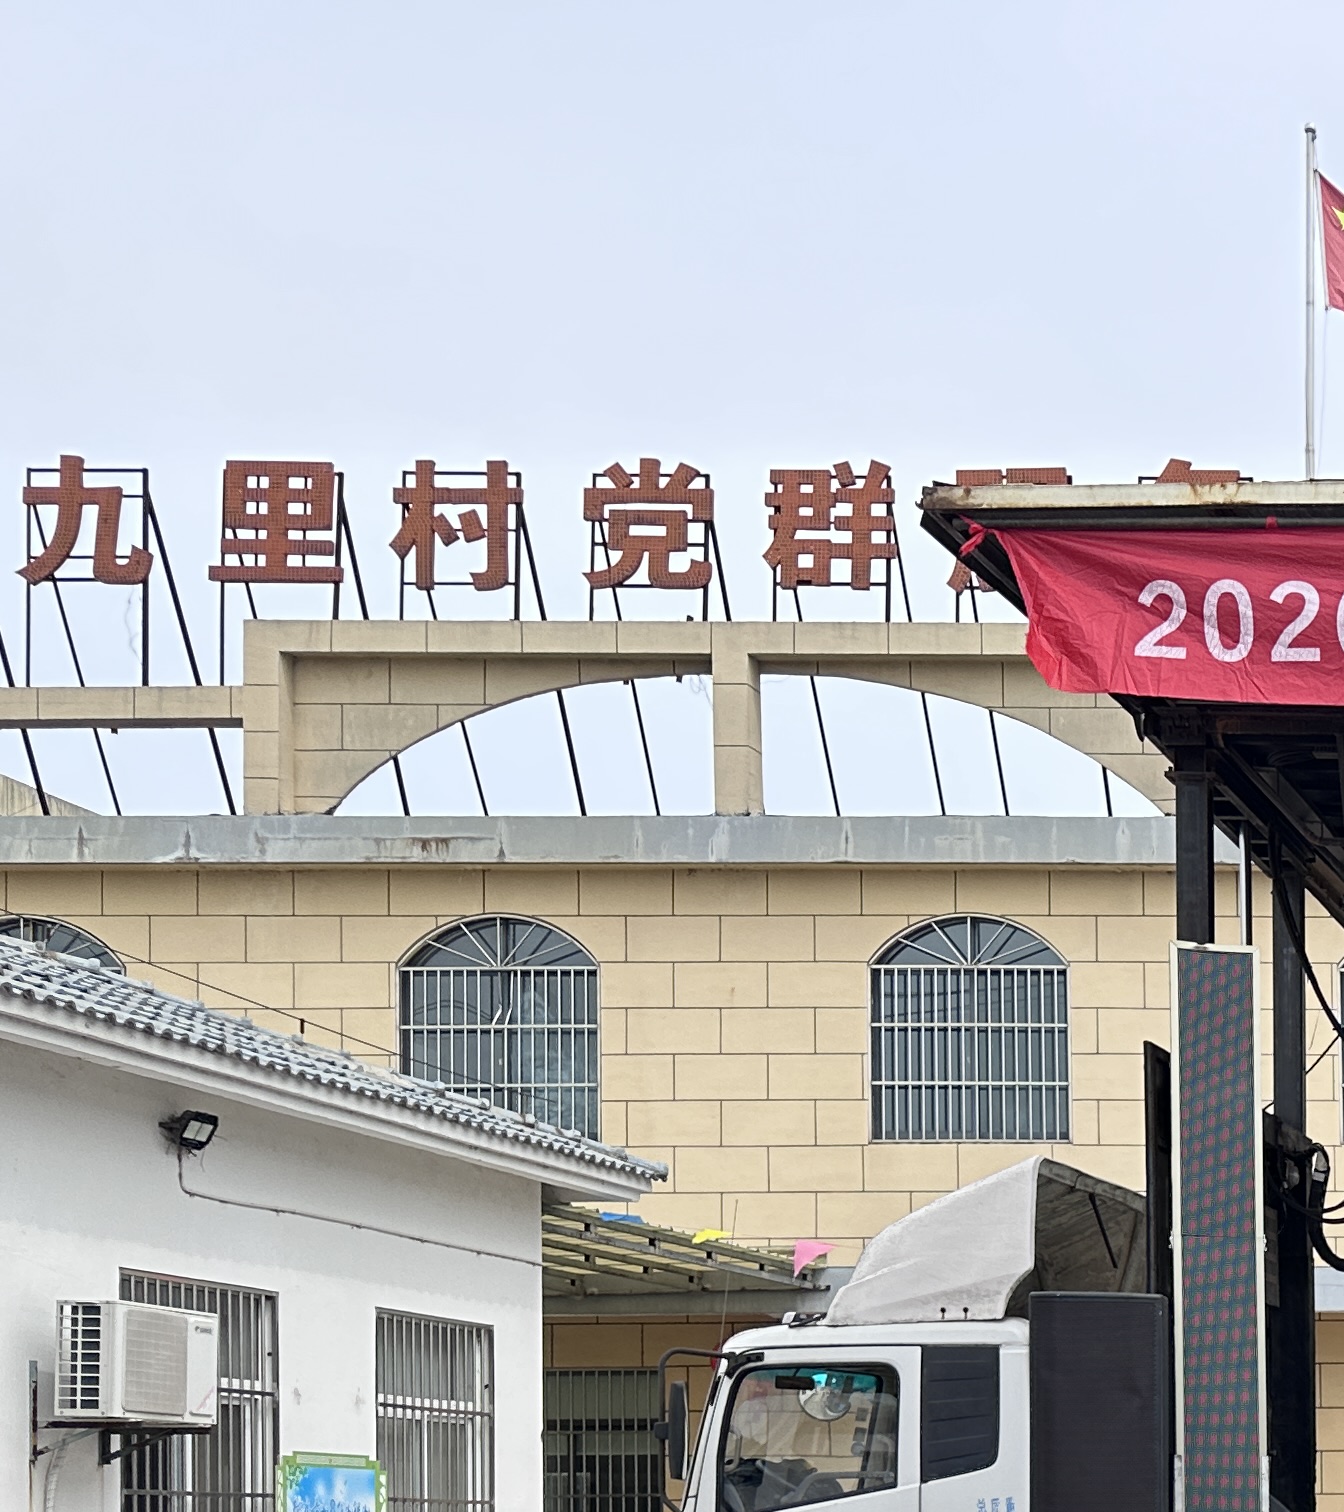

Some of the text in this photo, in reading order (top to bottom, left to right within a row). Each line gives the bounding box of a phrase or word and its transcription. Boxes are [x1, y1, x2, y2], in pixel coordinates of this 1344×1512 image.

[17, 454, 1072, 592] 九里村党群
